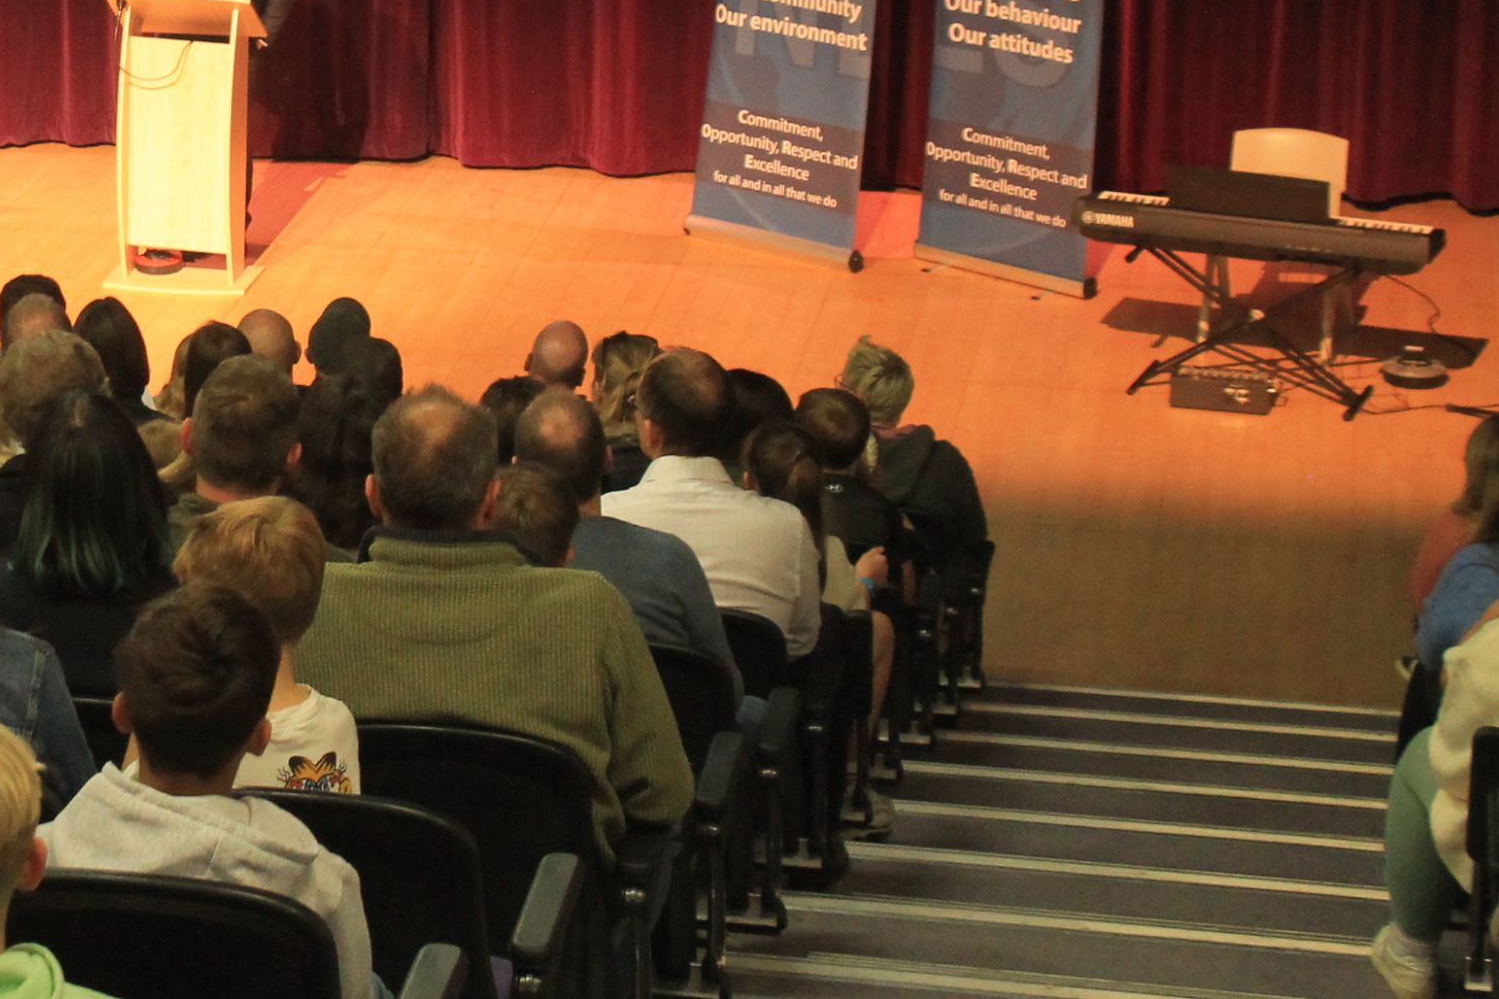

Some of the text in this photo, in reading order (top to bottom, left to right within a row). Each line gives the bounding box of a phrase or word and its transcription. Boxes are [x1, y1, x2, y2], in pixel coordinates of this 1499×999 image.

[716, 4, 868, 50] Our environment
[948, 23, 1073, 63] Our attitudes
[738, 110, 823, 141] Commitment,
[962, 128, 1050, 159] Commitment,
[702, 124, 858, 169] Opportunity, Respect and
[926, 142, 1088, 189] Opportunity, Respect and
[744, 154, 810, 180] Excellence
[714, 170, 837, 208] for all and in all that we do
[970, 173, 1038, 200] Excellence
[939, 189, 1067, 228] for all and in all that we do
[1095, 213, 1134, 228] YAMAHA
